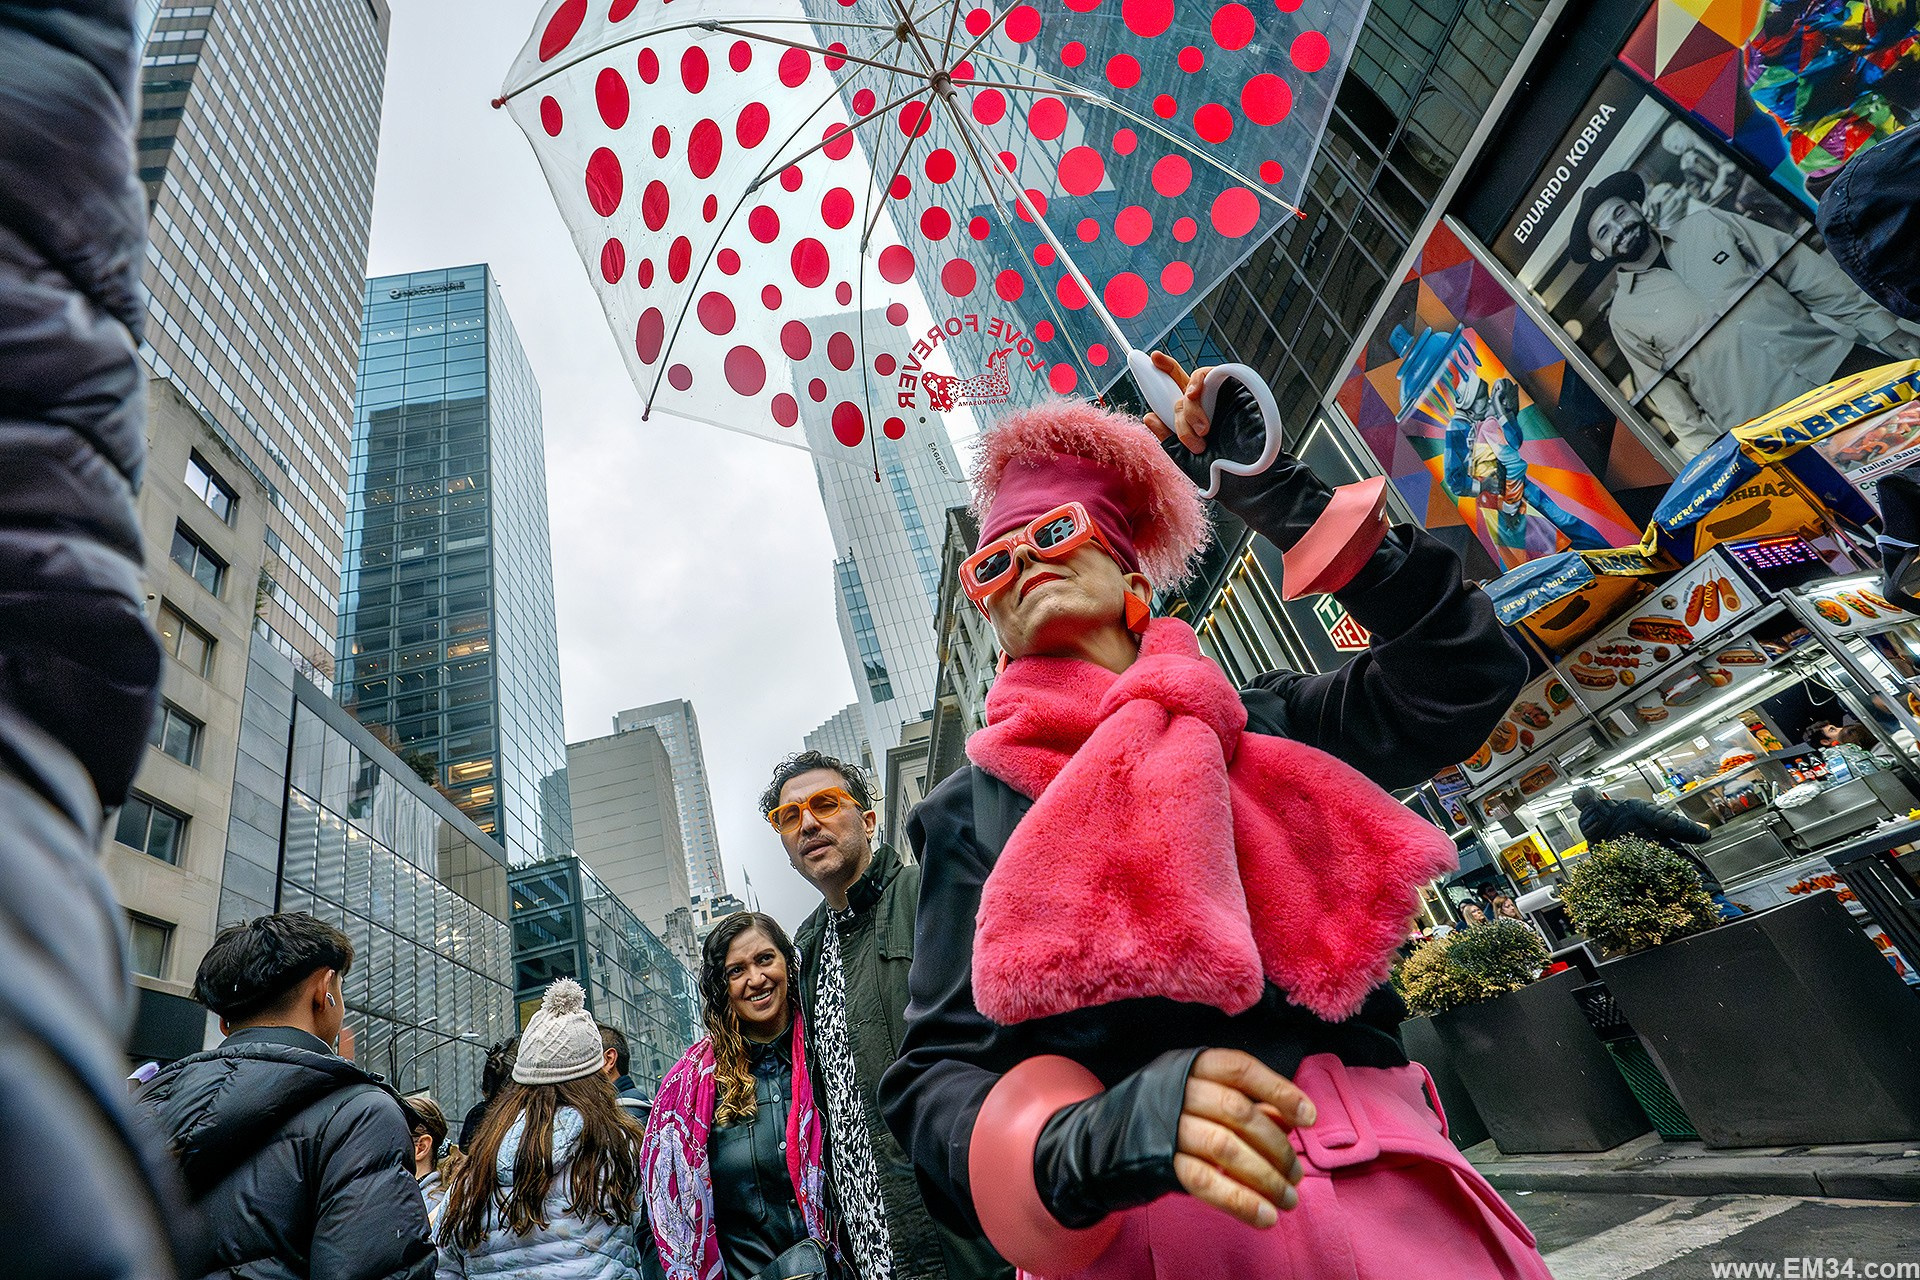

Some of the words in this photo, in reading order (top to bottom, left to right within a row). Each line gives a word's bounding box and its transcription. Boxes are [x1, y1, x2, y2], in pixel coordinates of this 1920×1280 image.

[1513, 166, 1571, 244] EDUARDO
[1565, 103, 1617, 167] KOBRA
[1859, 458, 1893, 474] Italian
[1893, 446, 1920, 460] Saus
[1694, 494, 1705, 507] ON
[1712, 472, 1731, 492] ROLL
